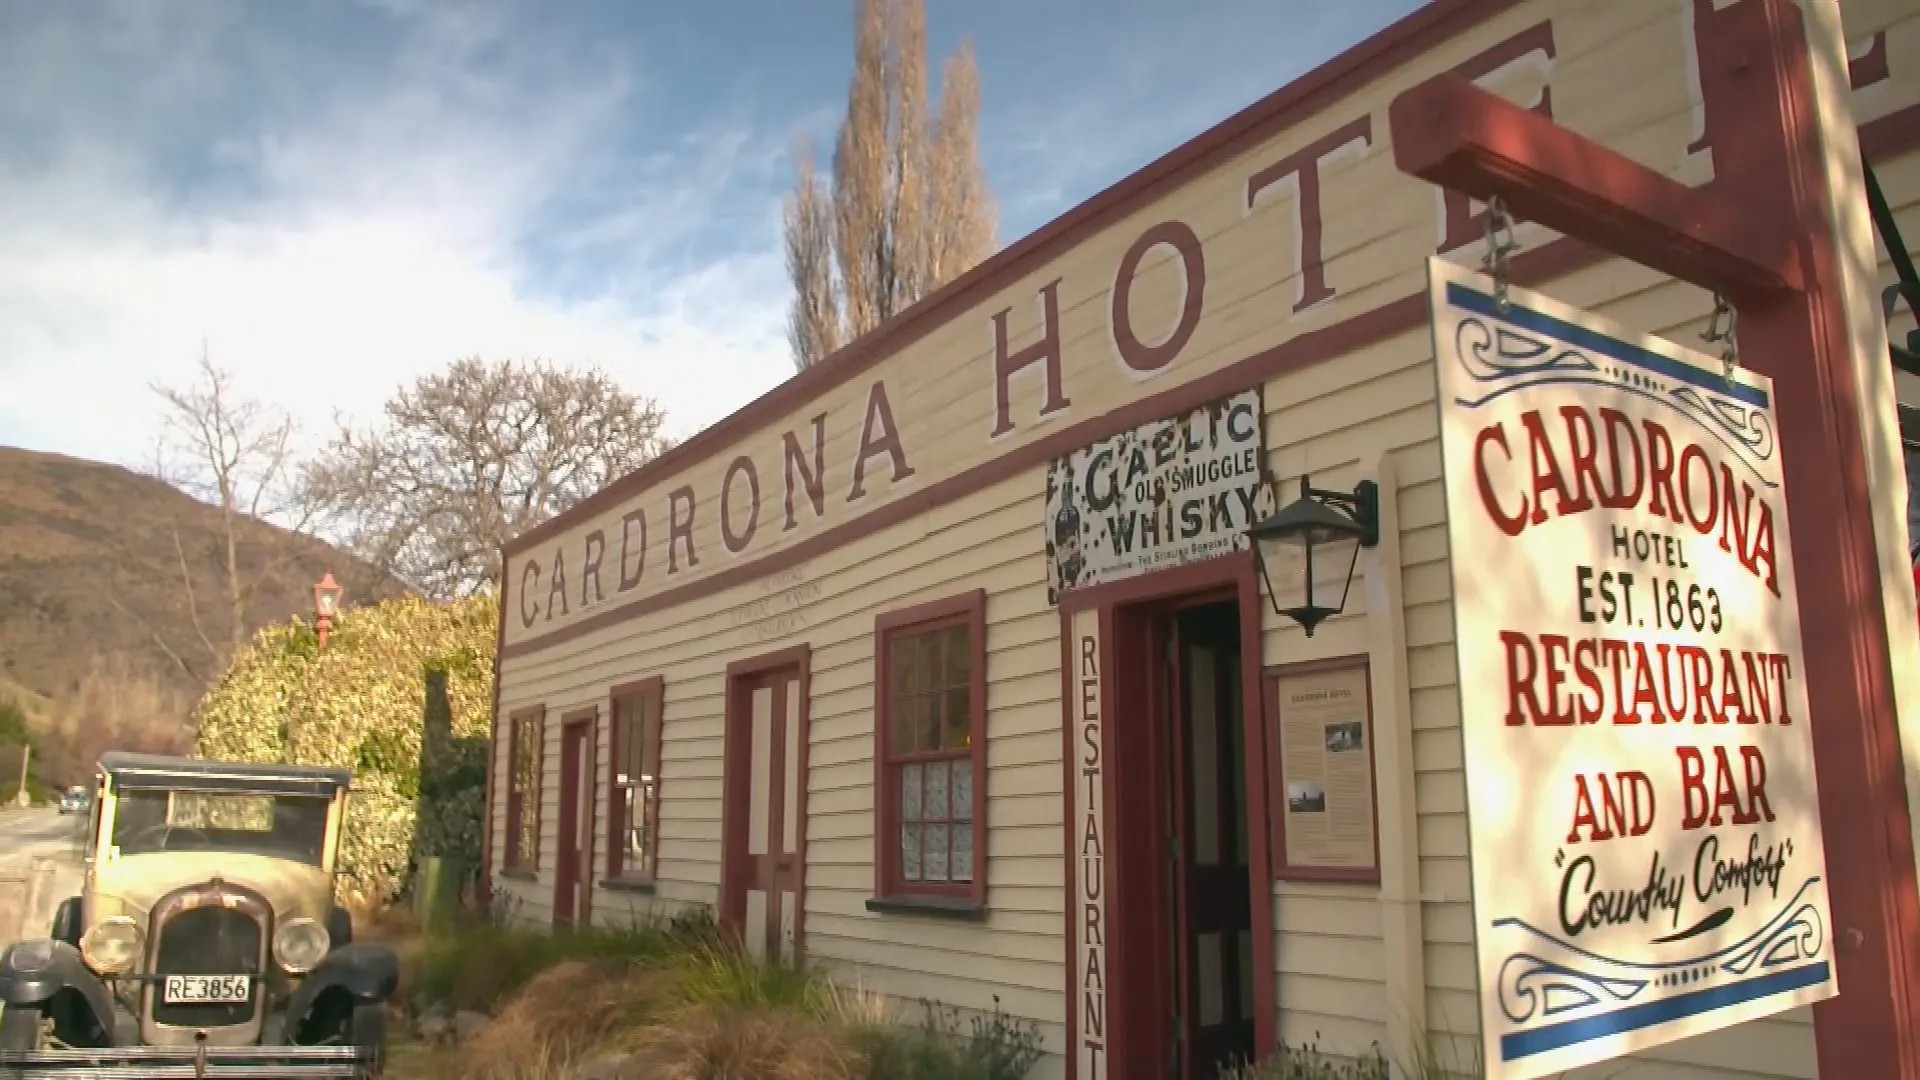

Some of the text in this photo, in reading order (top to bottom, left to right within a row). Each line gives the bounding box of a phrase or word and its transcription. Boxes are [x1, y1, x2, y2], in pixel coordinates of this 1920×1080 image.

[520, 379, 915, 629] CARDRONA
[1106, 484, 1259, 557] WHISKY
[1474, 405, 1781, 599] CARDRONA
[1611, 524, 1689, 569] HOTEL
[1576, 565, 1723, 635] EST. 1863
[1499, 630, 1793, 727] RESTAURANT
[1566, 745, 1776, 844] AND BAR
[1080, 634, 1104, 1080] RESTAURANT
[168, 975, 247, 999] RE3856
